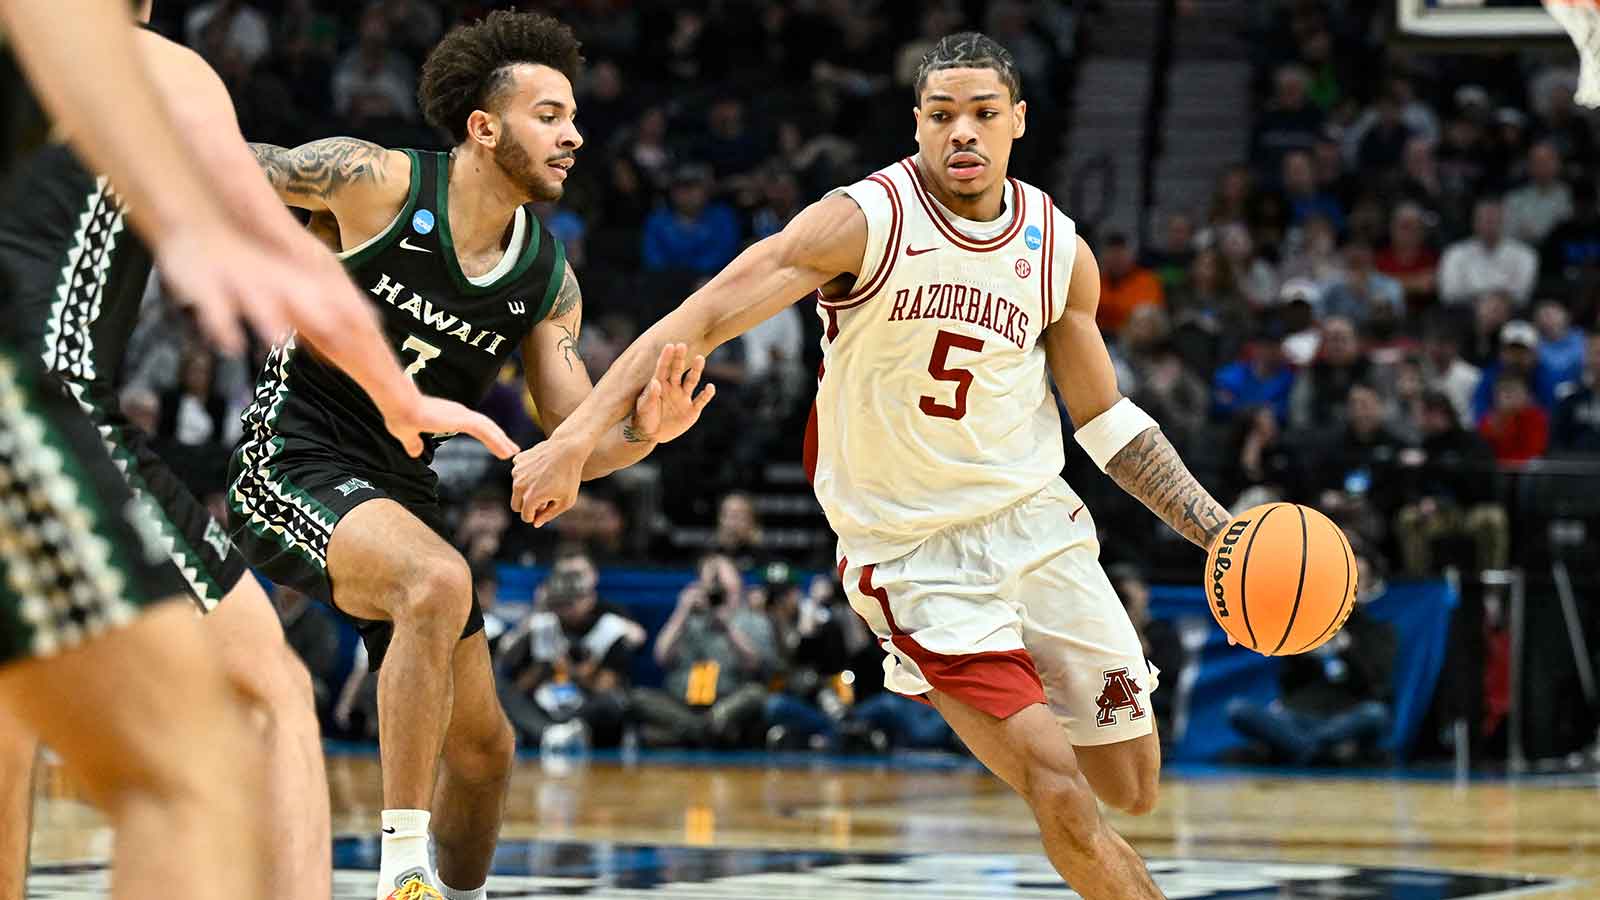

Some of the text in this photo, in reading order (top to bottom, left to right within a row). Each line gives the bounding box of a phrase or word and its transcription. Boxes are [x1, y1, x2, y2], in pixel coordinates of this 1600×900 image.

[888, 283, 1029, 350] RAZORBACKS
[401, 335, 441, 385] 7
[919, 329, 985, 421] 5
[1213, 519, 1252, 618] Wilson
[1096, 666, 1146, 728] A
